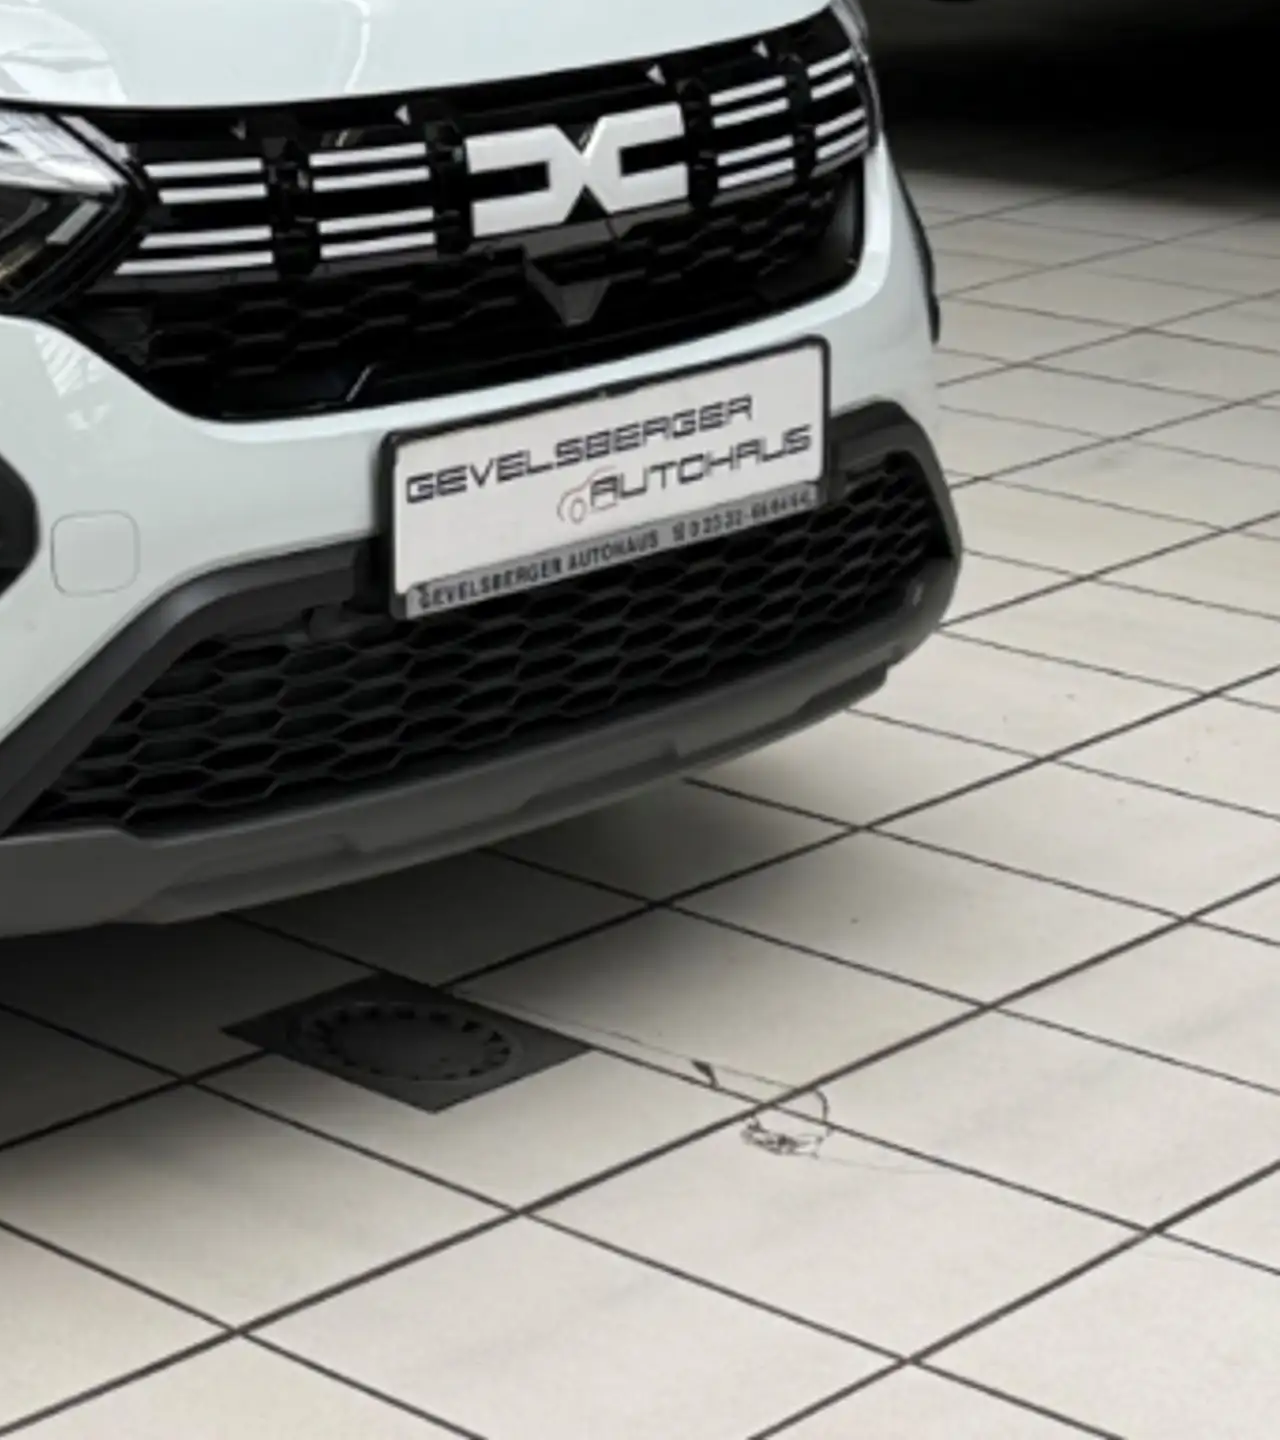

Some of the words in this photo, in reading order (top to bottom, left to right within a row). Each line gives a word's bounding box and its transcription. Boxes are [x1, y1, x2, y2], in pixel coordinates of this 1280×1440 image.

[406, 394, 753, 504] GEVELSBERGER
[589, 423, 812, 507] AUTOHAUS
[567, 529, 659, 572] AUTOHAUS
